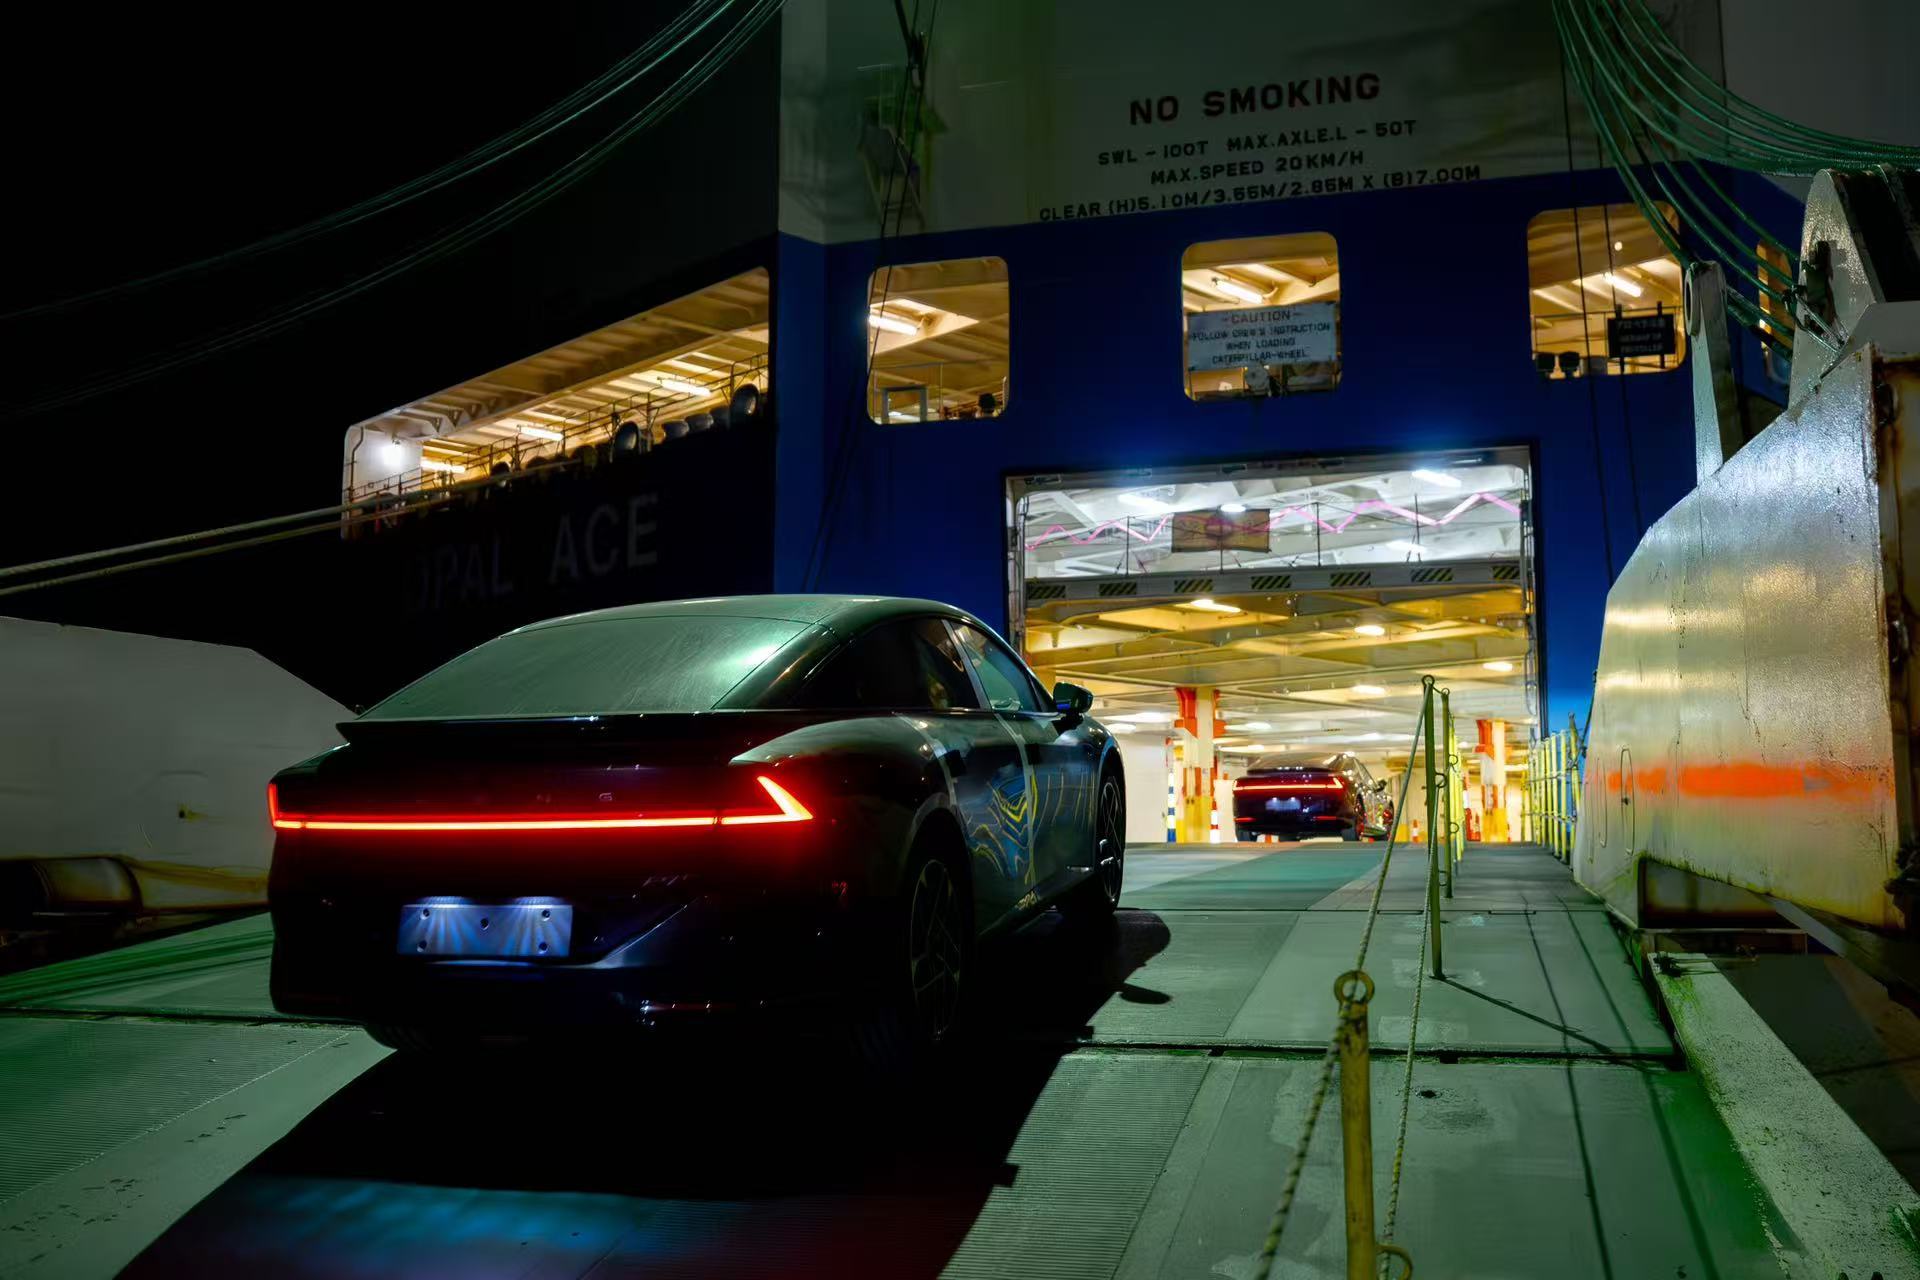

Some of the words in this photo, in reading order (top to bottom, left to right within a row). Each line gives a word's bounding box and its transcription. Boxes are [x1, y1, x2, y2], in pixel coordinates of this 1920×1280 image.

[1130, 95, 1179, 126] NO
[1203, 72, 1381, 117] SMOKING
[1098, 149, 1138, 166] SWL
[1164, 140, 1209, 159] 100T
[1227, 126, 1347, 152] MAX.AXLE.L
[1375, 119, 1417, 137] 50T
[1151, 160, 1264, 185] MAX.SPEED
[1276, 150, 1364, 172] 20KM/H
[1040, 202, 1101, 221] CLEAR
[1363, 175, 1375, 189] X
[1384, 164, 1481, 188] (B)7.00M
[1192, 330, 1228, 342] FOLLOW
[1270, 322, 1330, 336] INSTRUCTION
[1226, 340, 1251, 350] WHEN
[1256, 337, 1296, 349] LOADING
[548, 491, 658, 585] ACE
